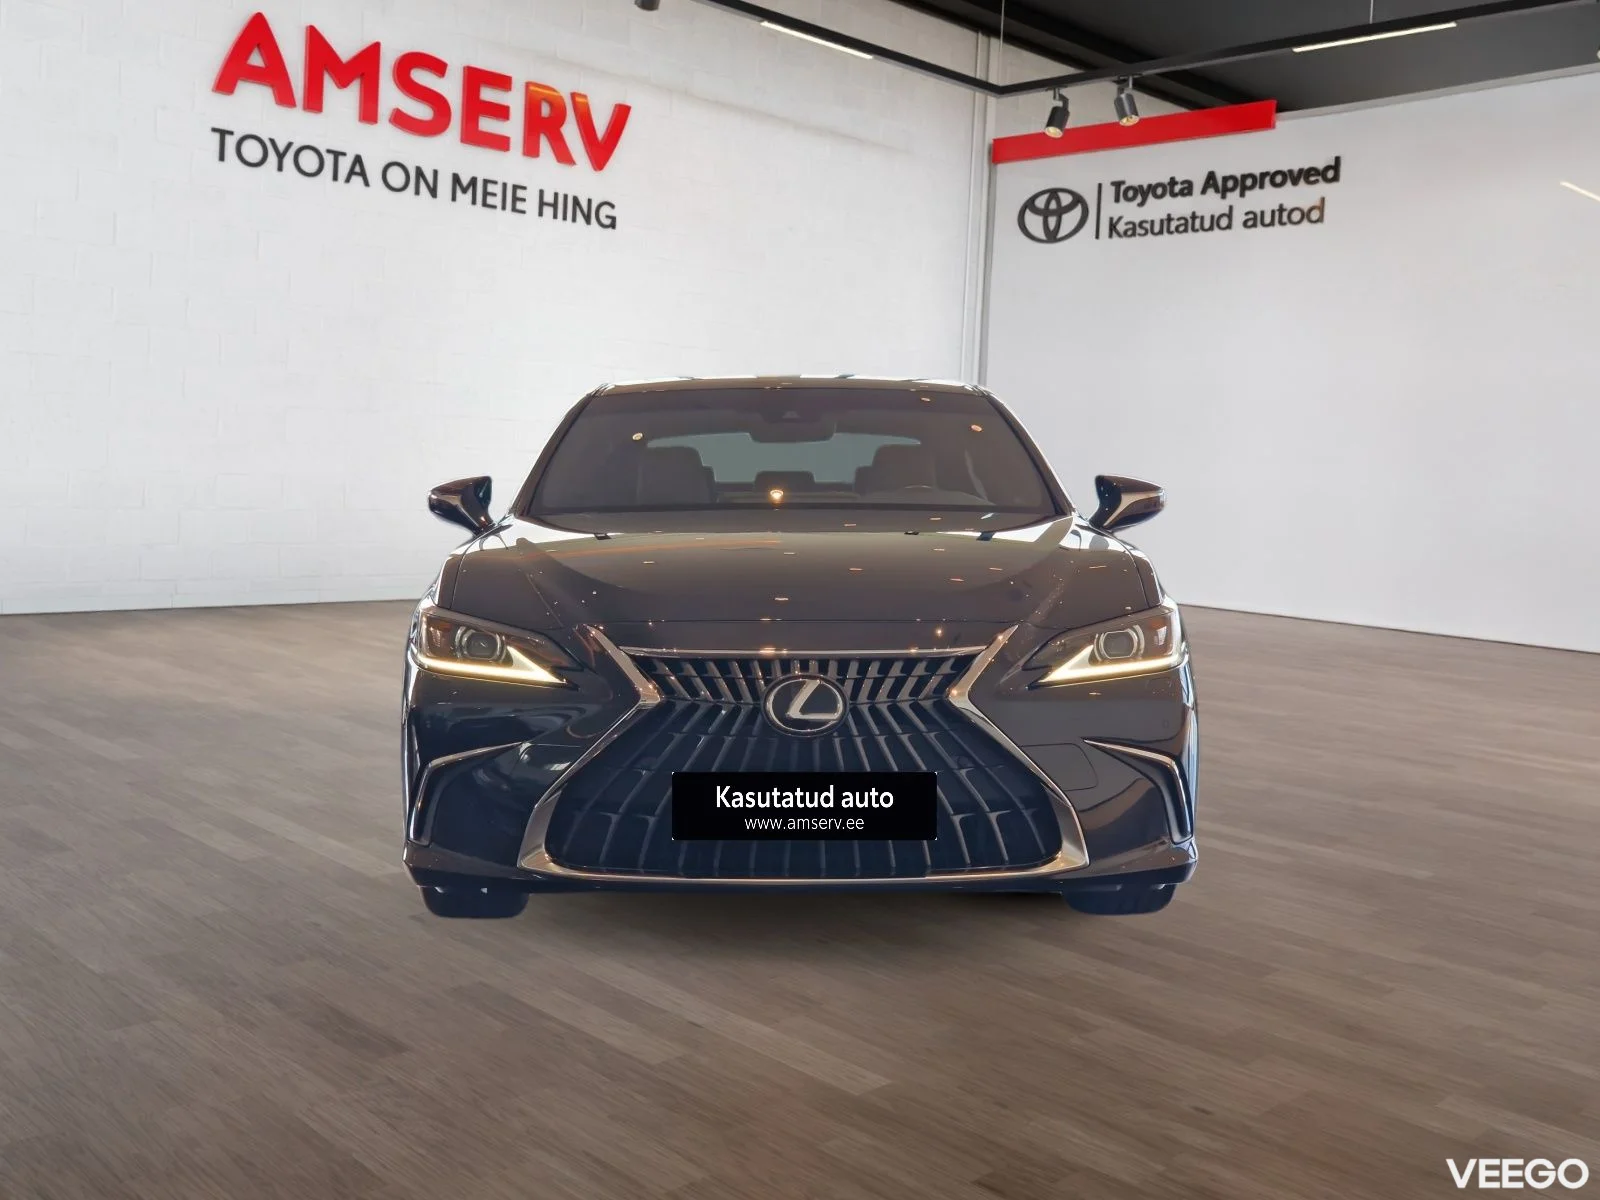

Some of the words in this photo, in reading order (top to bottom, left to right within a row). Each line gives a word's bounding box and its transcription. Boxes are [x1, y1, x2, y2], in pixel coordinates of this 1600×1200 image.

[211, 11, 632, 172] AMSERV
[211, 126, 370, 188] TOYOTA
[381, 160, 439, 199] ON
[451, 172, 528, 215] MEIE
[538, 188, 617, 230] HING
[1110, 176, 1194, 208] Toyota
[1200, 155, 1342, 199] Approved
[1108, 204, 1233, 239] Kasutatud
[1242, 196, 1326, 229] autod
[715, 784, 834, 809] Kasutatud
[841, 787, 894, 809] auto
[744, 816, 865, 831] www.amserv.ee
